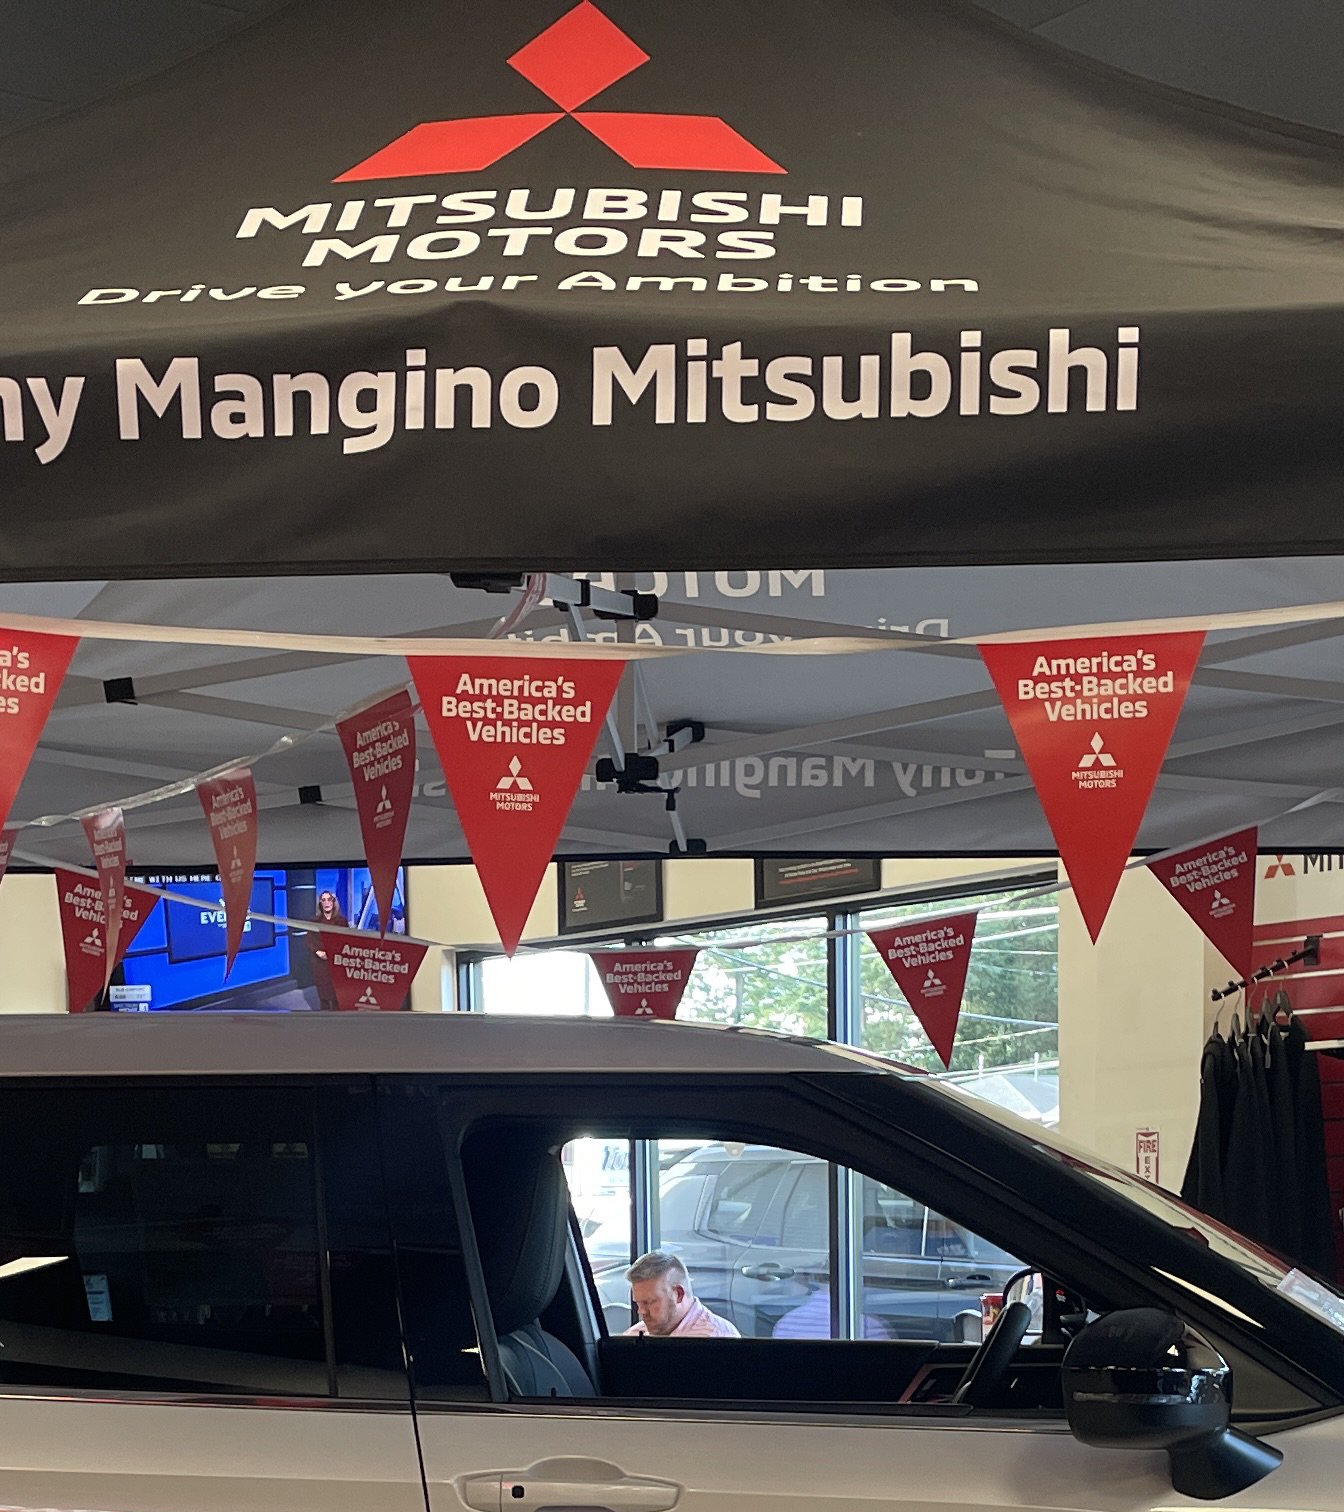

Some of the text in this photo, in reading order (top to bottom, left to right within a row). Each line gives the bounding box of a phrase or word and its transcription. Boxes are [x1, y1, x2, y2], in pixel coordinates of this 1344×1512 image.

[236, 188, 863, 239] MITSUBISHI
[301, 226, 777, 267] MOTORS
[77, 270, 980, 305] Drive your Ambition
[115, 348, 561, 453] Mangino
[588, 326, 1142, 427] Mitsubishi
[1031, 648, 1157, 677] America's
[455, 673, 576, 699] America's
[1017, 671, 1174, 700] Best-Backed
[441, 695, 592, 724] Best-Backed
[1044, 697, 1148, 722] Vehicles
[356, 720, 400, 748] America's
[465, 720, 566, 745] Vehicles
[352, 728, 409, 768] Best-Backed
[363, 754, 403, 782] Vehicles
[1071, 769, 1124, 781] MITSUBISHI
[489, 791, 540, 802] MITSUBISHI
[1078, 779, 1117, 789] MOTORS
[495, 801, 533, 811] MOTORS
[1169, 851, 1248, 888] Best-Backed
[1174, 846, 1236, 875] America's
[1186, 868, 1239, 893] Vehicles
[887, 934, 965, 960] Best-Backed
[894, 926, 954, 948] America's
[333, 954, 409, 974] Best-Backed
[341, 944, 402, 961] America's
[902, 950, 954, 968] Vehicles
[345, 967, 395, 984] Vehicles
[605, 969, 682, 984] Best-Backed
[613, 960, 673, 973] America's
[618, 982, 669, 994] Vehicles
[1138, 1139, 1157, 1153] FIRE
